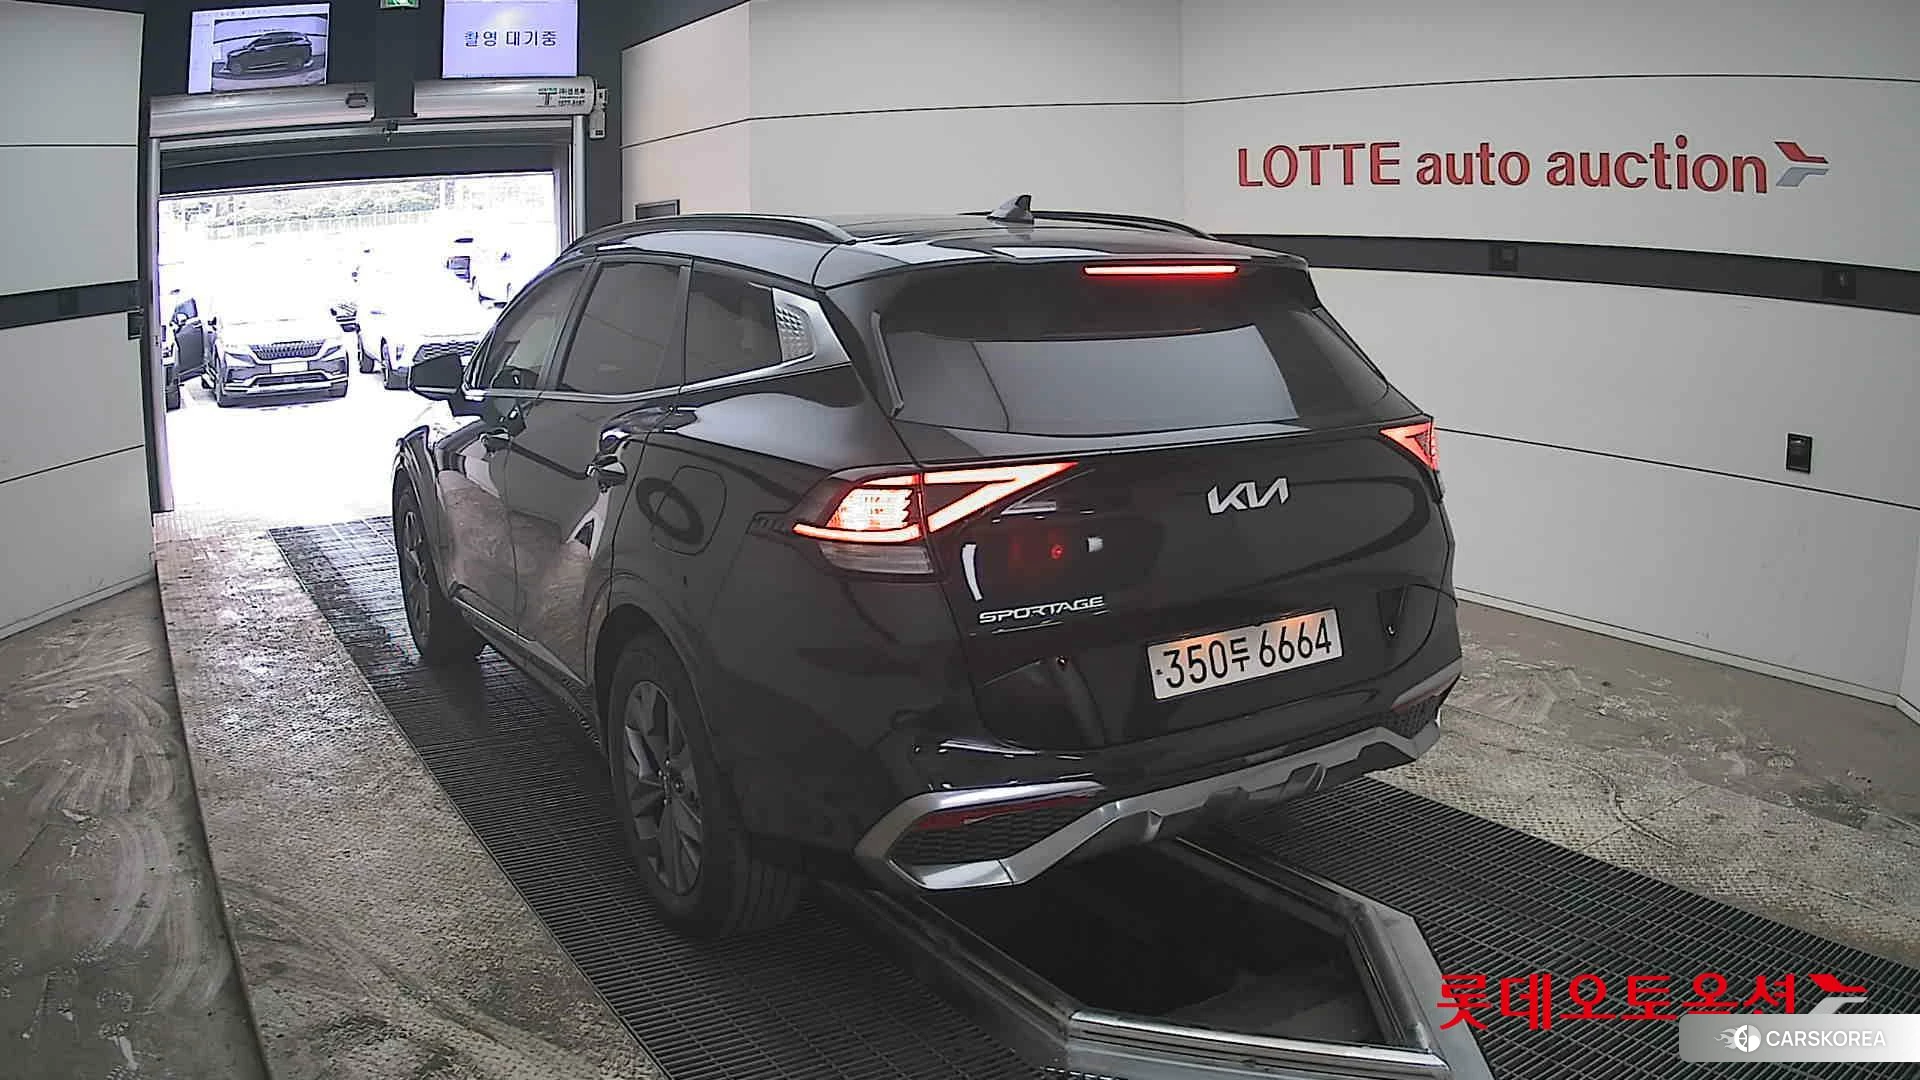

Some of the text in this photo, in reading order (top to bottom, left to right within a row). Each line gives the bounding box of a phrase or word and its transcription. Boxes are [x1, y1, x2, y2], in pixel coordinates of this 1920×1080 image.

[465, 30, 556, 47] 촬영 대기중
[1237, 135, 1768, 194] LOTTE auto auction
[1208, 477, 1289, 515] KIA
[979, 596, 1105, 624] SPORTAGE
[1162, 616, 1333, 690] 350두 6664
